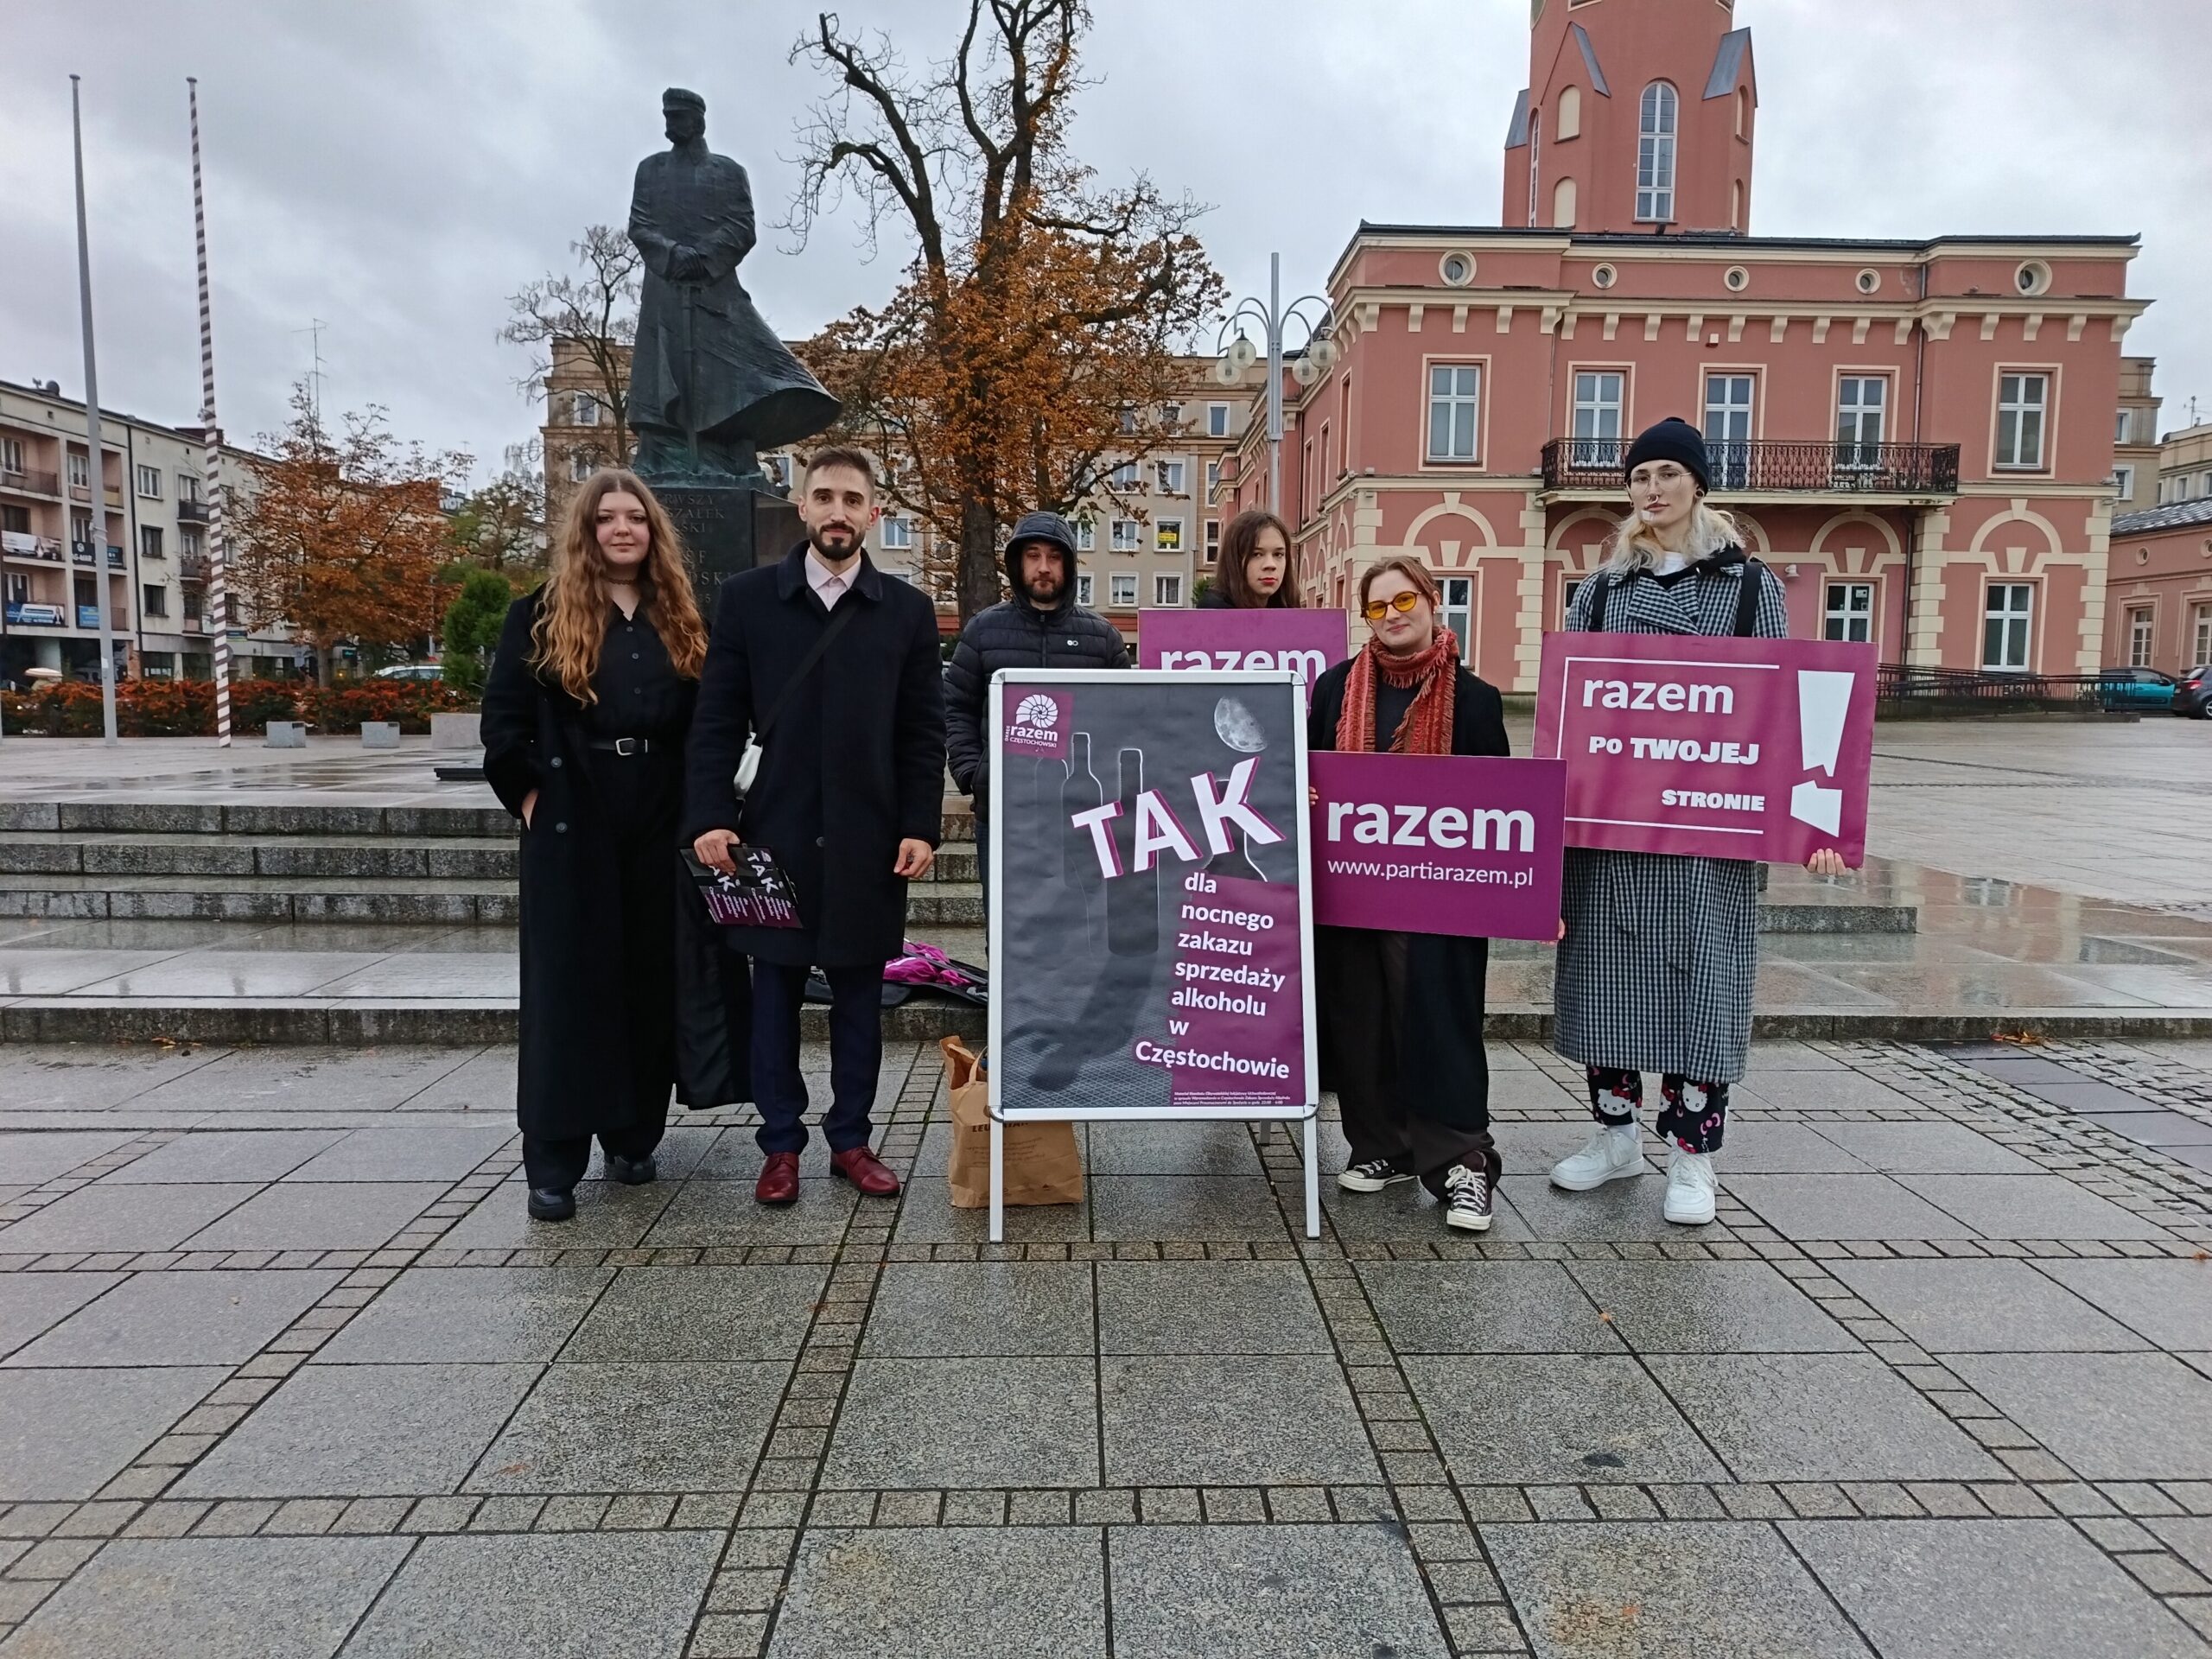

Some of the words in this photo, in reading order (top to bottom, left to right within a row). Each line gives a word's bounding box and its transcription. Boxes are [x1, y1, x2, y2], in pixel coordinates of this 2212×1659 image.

[1160, 649, 1326, 677] razem
[1582, 678, 1734, 715] razem
[1009, 737, 1057, 748] CZĘSTOCHOWSKI
[1011, 726, 1058, 741] razem
[1588, 735, 1623, 755] PO
[1630, 737, 1759, 766] TWOJEJ
[1662, 789, 1765, 812] STRONIE
[1071, 756, 1286, 880] TAK
[1327, 800, 1535, 853] razem
[1184, 872, 1217, 893] dla
[1327, 859, 1534, 888] www.partiarazem.pl
[1181, 904, 1274, 931] nocnego
[1178, 931, 1253, 956] zakazu
[1174, 961, 1286, 992] sprzedaży
[1172, 987, 1267, 1016] alkoholu
[1169, 1020, 1190, 1036] w
[1135, 1040, 1290, 1079] Częstochowie
